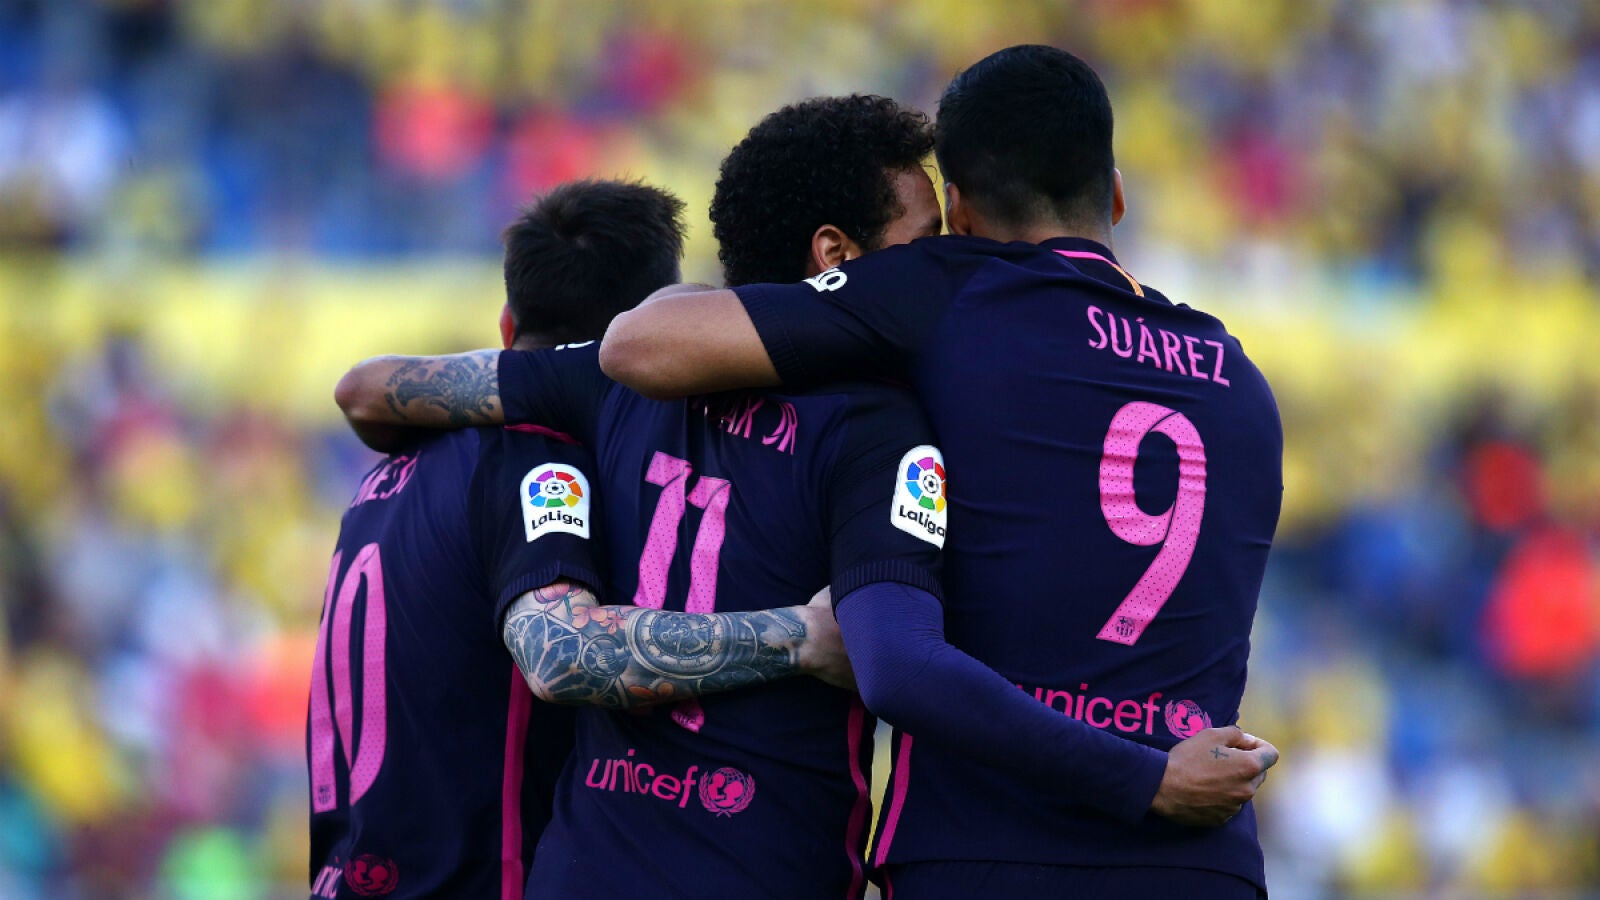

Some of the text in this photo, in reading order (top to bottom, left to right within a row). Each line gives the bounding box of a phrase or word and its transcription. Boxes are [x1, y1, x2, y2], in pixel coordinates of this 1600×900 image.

[1087, 305, 1230, 387] SUÁREZ
[531, 510, 583, 530] LaLiga
[899, 505, 945, 538] LaLiga
[1097, 401, 1207, 646] 9
[633, 452, 731, 733] 11
[306, 543, 387, 814] 10
[585, 749, 698, 808] unicef
